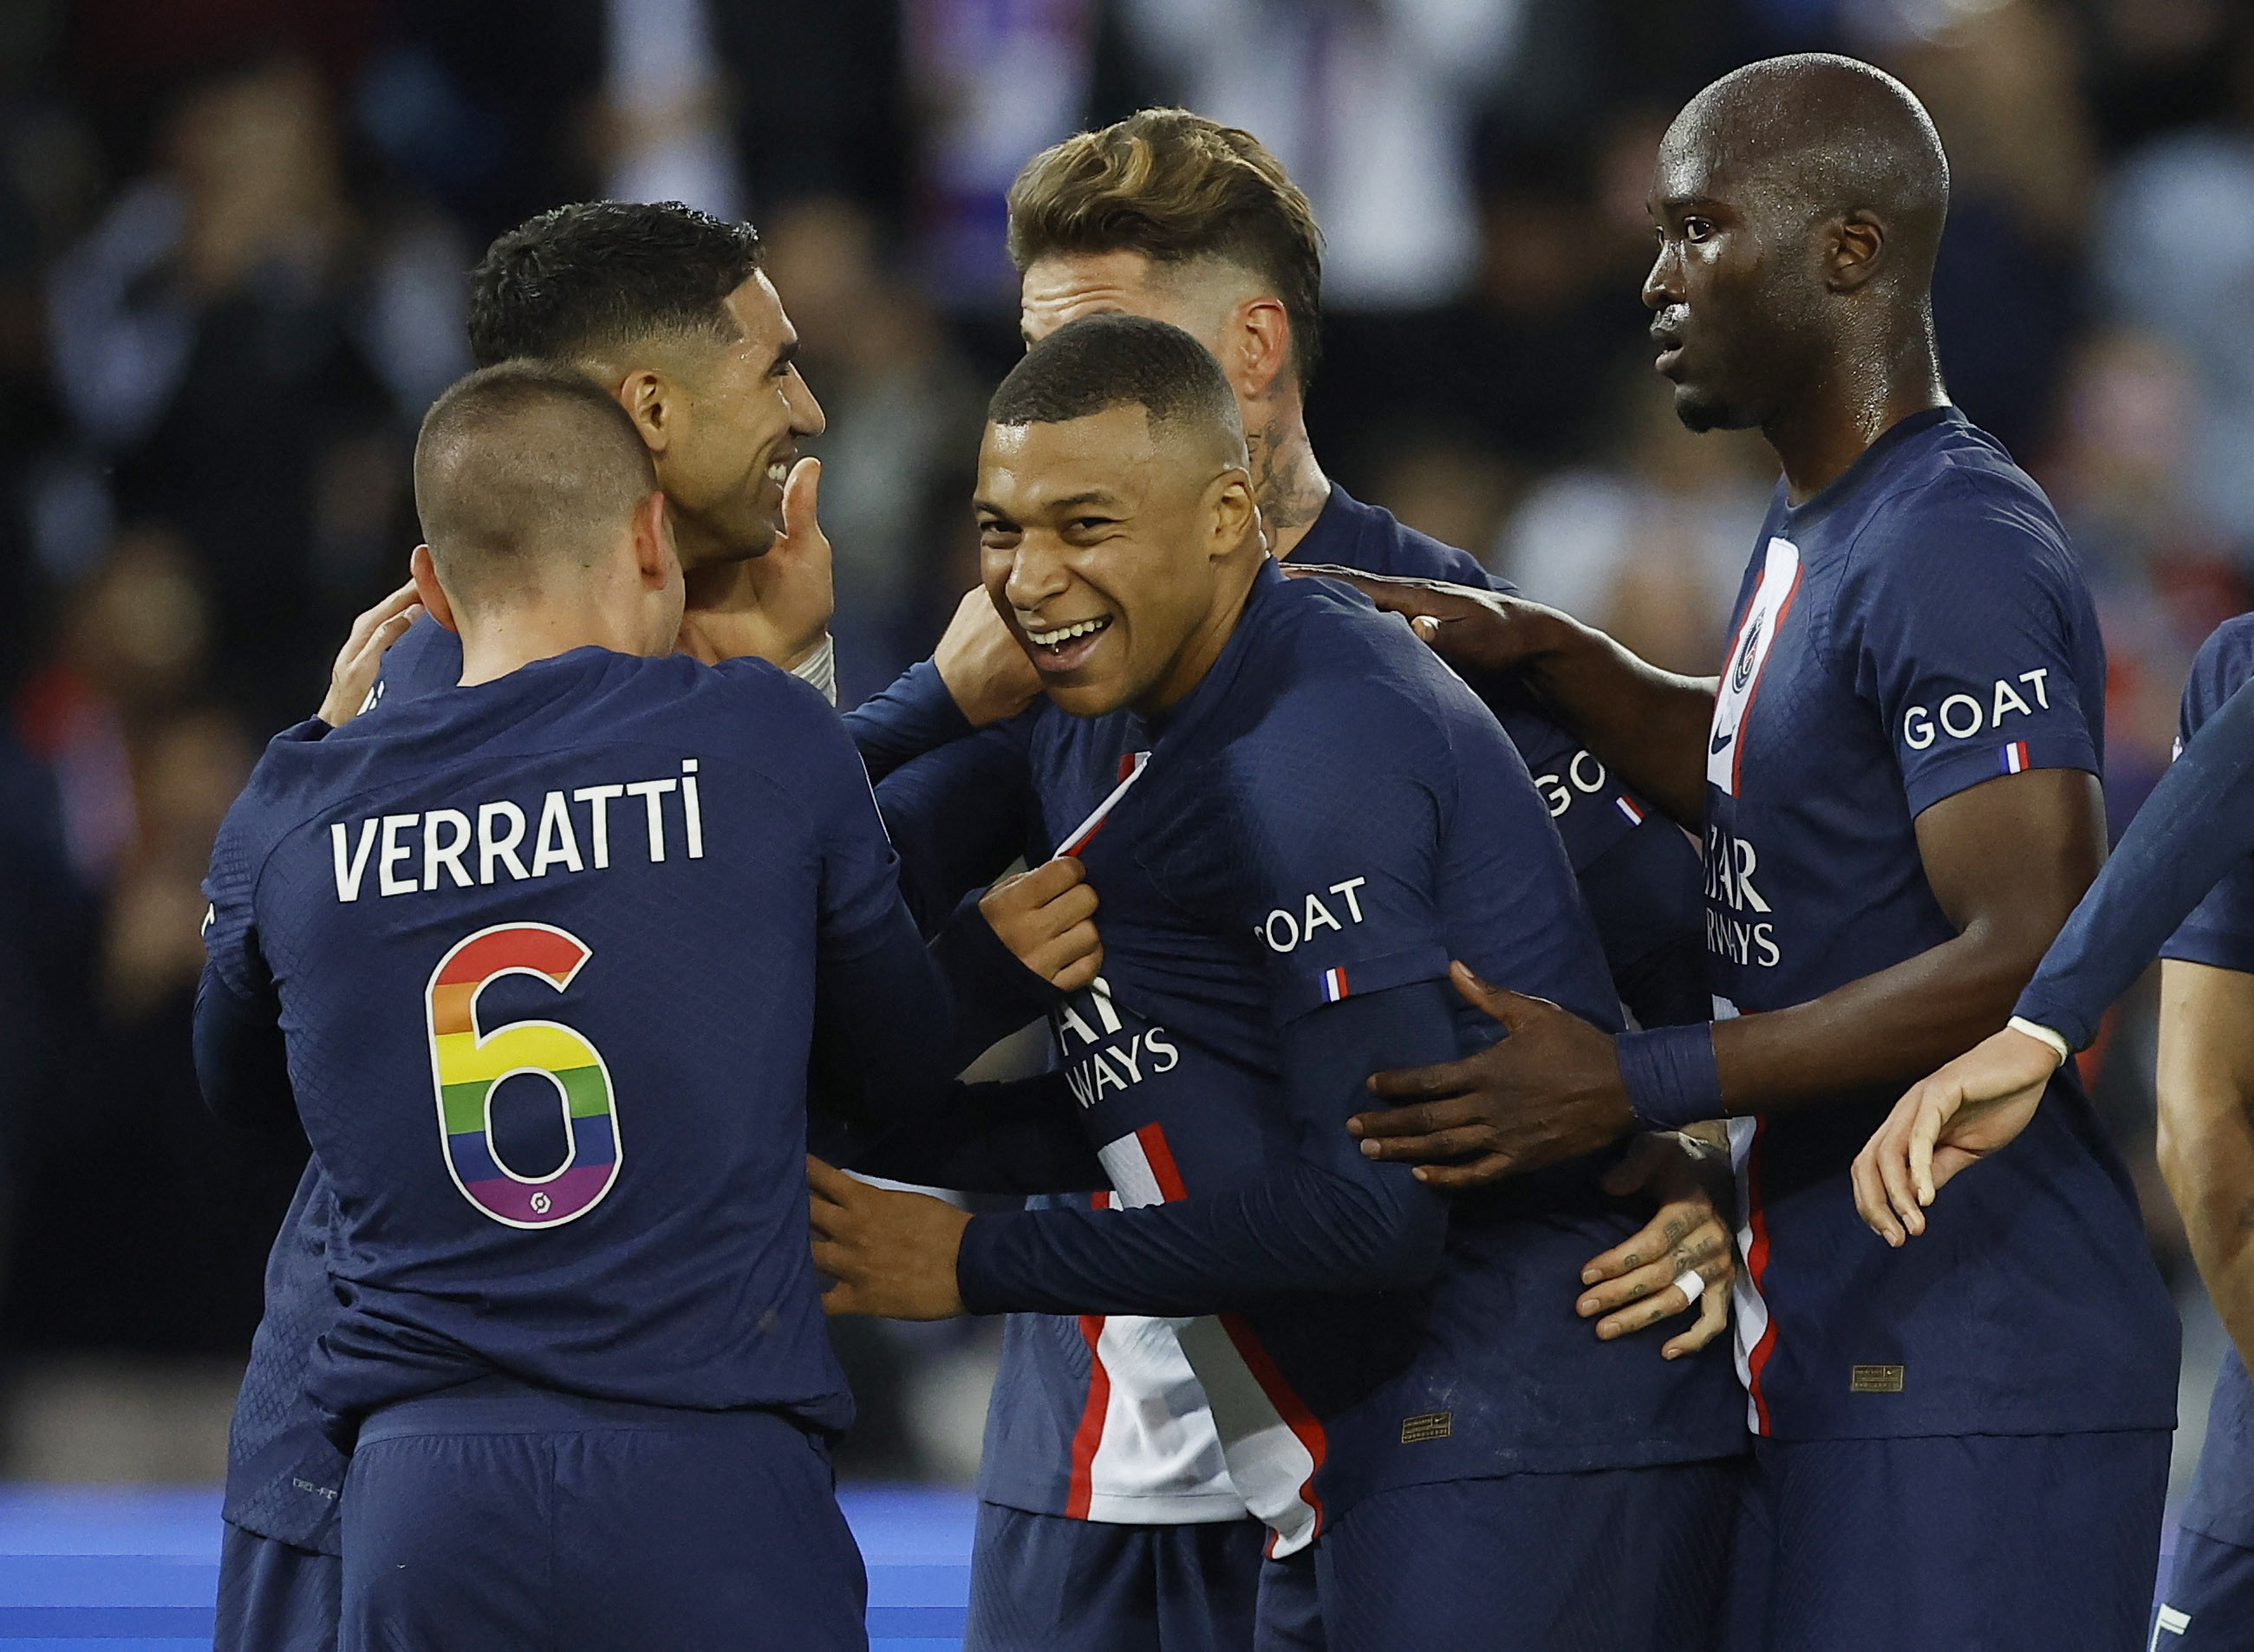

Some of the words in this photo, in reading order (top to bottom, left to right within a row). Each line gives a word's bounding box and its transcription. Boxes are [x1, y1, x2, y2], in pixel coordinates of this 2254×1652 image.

[1904, 668, 2049, 751] GOAT
[1254, 876, 1365, 953] OAT
[425, 921, 623, 1229] 6
